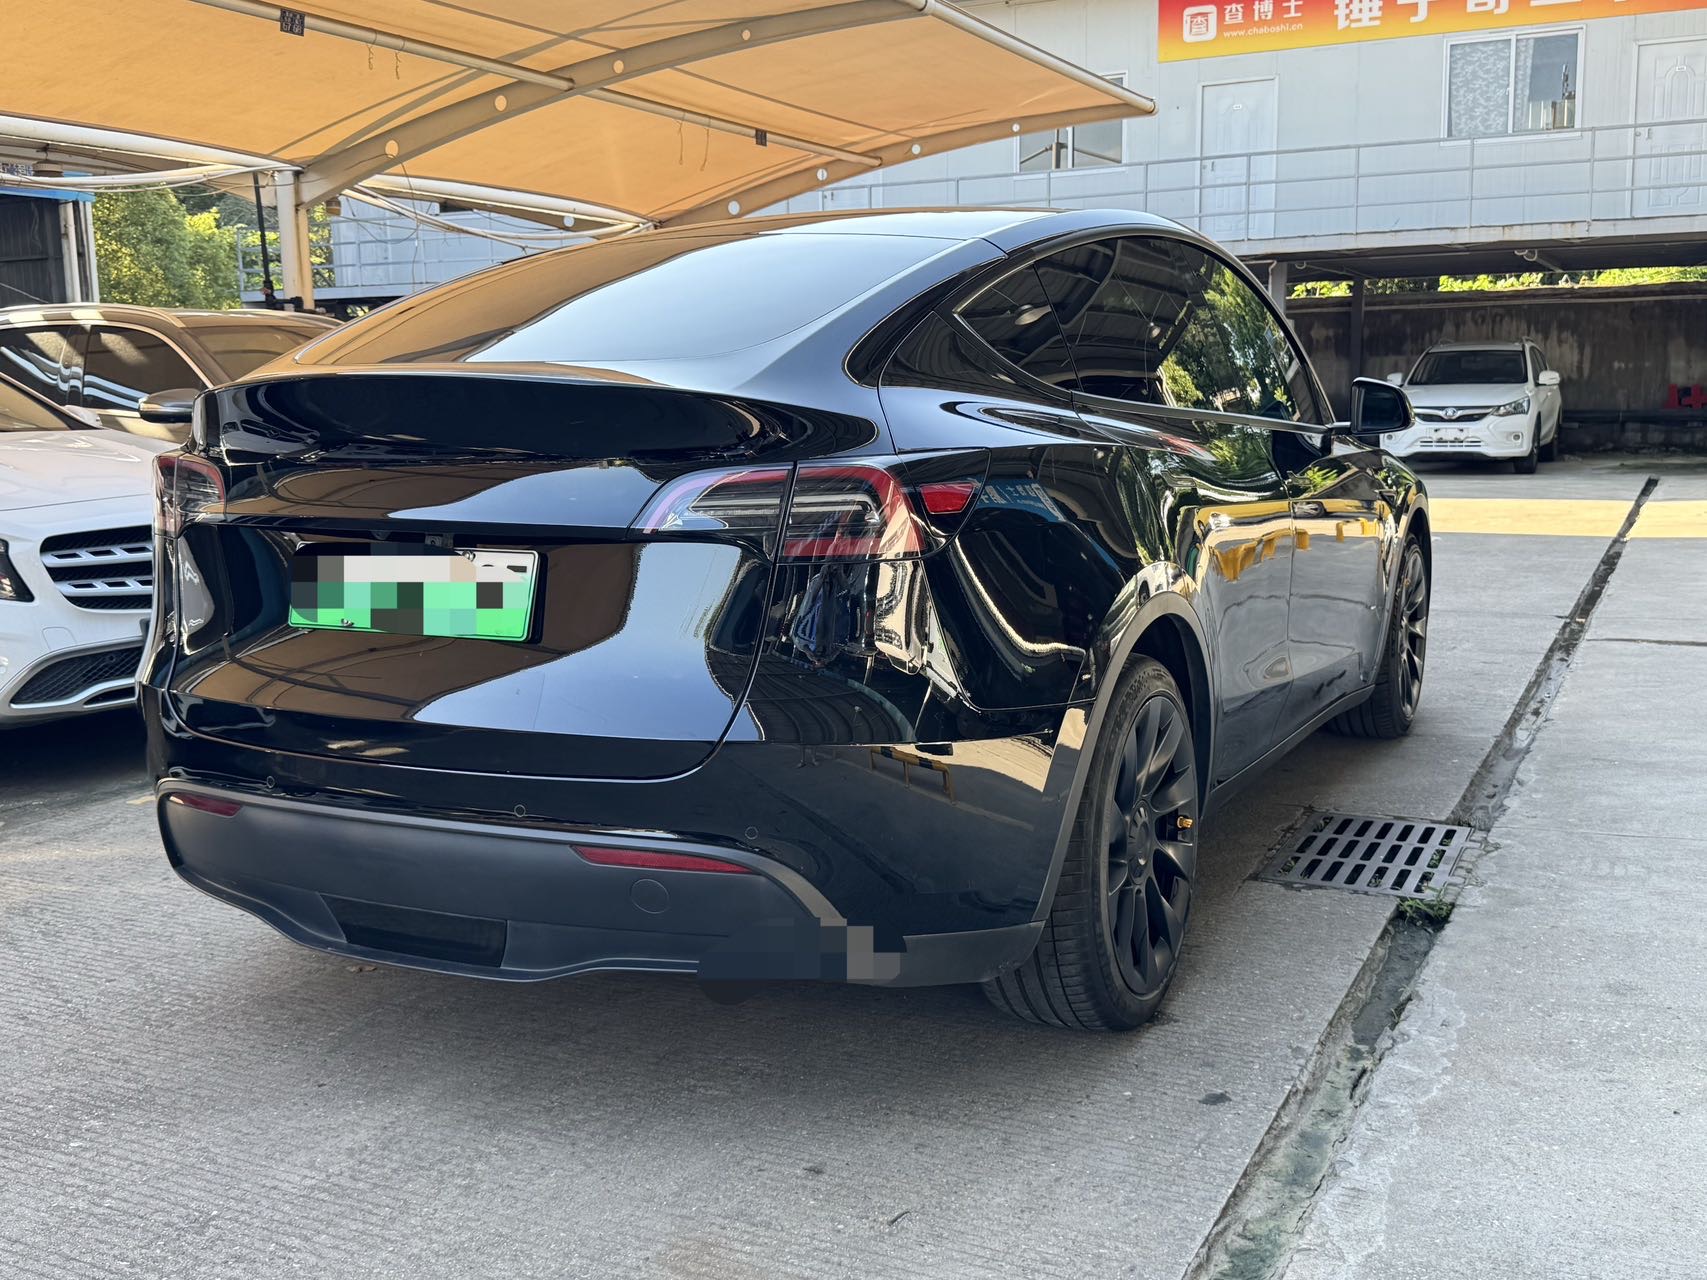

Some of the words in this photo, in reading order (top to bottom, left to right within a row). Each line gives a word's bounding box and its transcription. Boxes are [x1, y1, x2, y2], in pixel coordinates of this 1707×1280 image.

[1223, 0, 1303, 24] 查博士
[1223, 23, 1303, 38] www.chaboshi.cn
